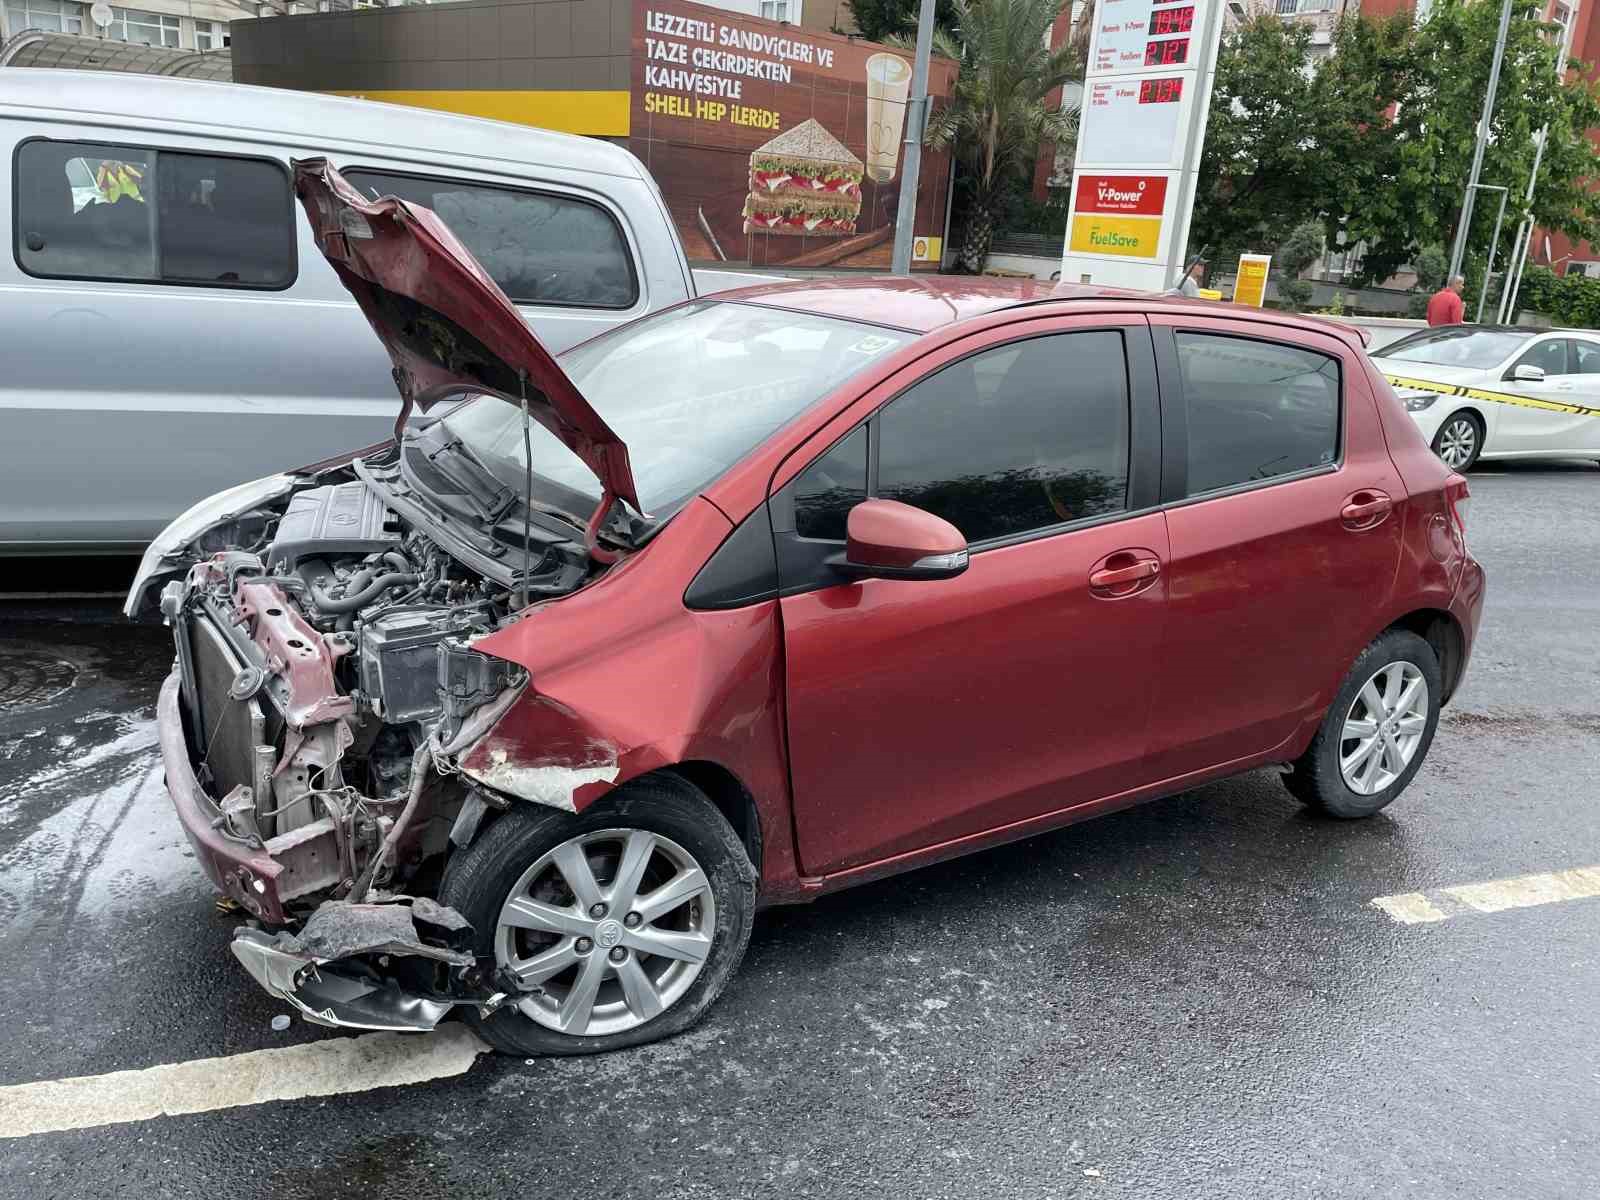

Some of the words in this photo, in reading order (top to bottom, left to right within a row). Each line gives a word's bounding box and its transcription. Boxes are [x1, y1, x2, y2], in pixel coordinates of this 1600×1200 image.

[645, 38, 687, 65] TAZE
[817, 47, 834, 68] VE
[644, 92, 692, 117] SHELL
[696, 100, 726, 121] HEP
[1097, 188, 1142, 202] V-Power
[1090, 232, 1138, 247] FuelSave
